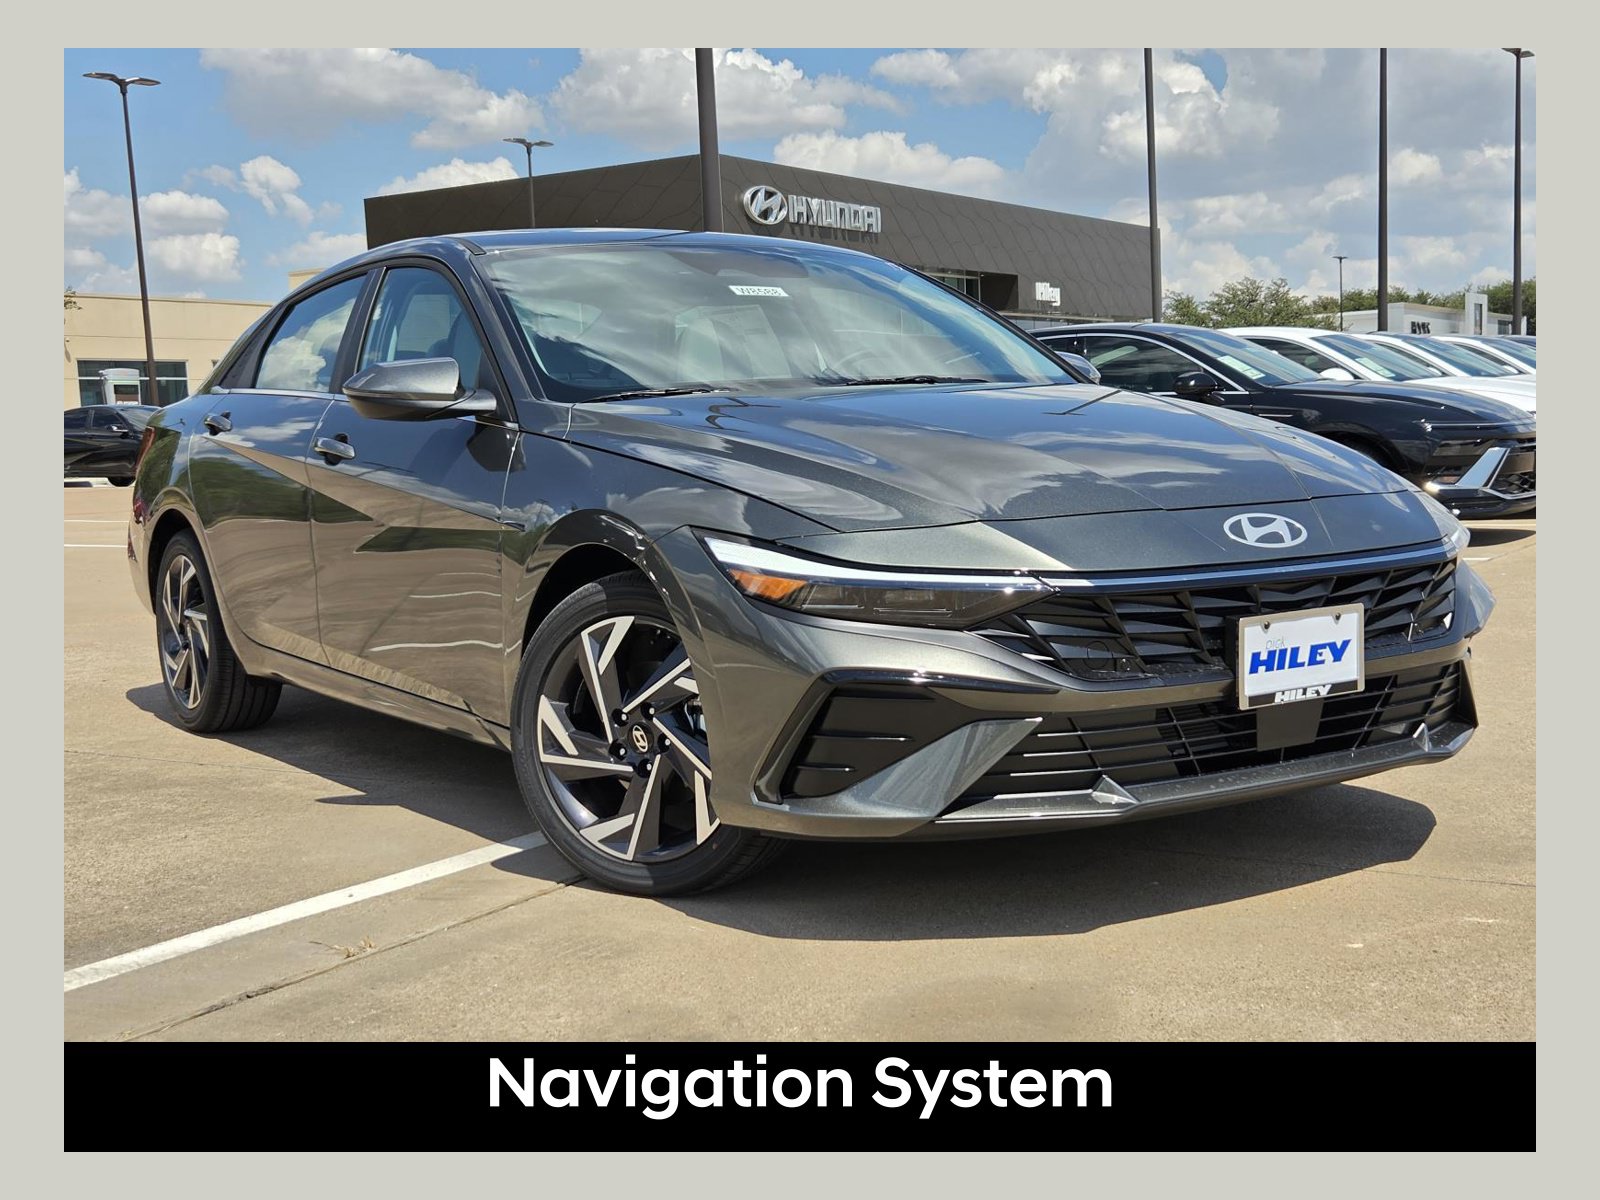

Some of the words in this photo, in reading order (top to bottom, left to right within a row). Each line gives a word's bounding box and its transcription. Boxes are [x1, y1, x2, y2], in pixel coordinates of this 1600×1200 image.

[788, 194, 882, 233] HYUNDAI
[1248, 638, 1352, 675] HILEY
[1274, 684, 1332, 703] HILEY
